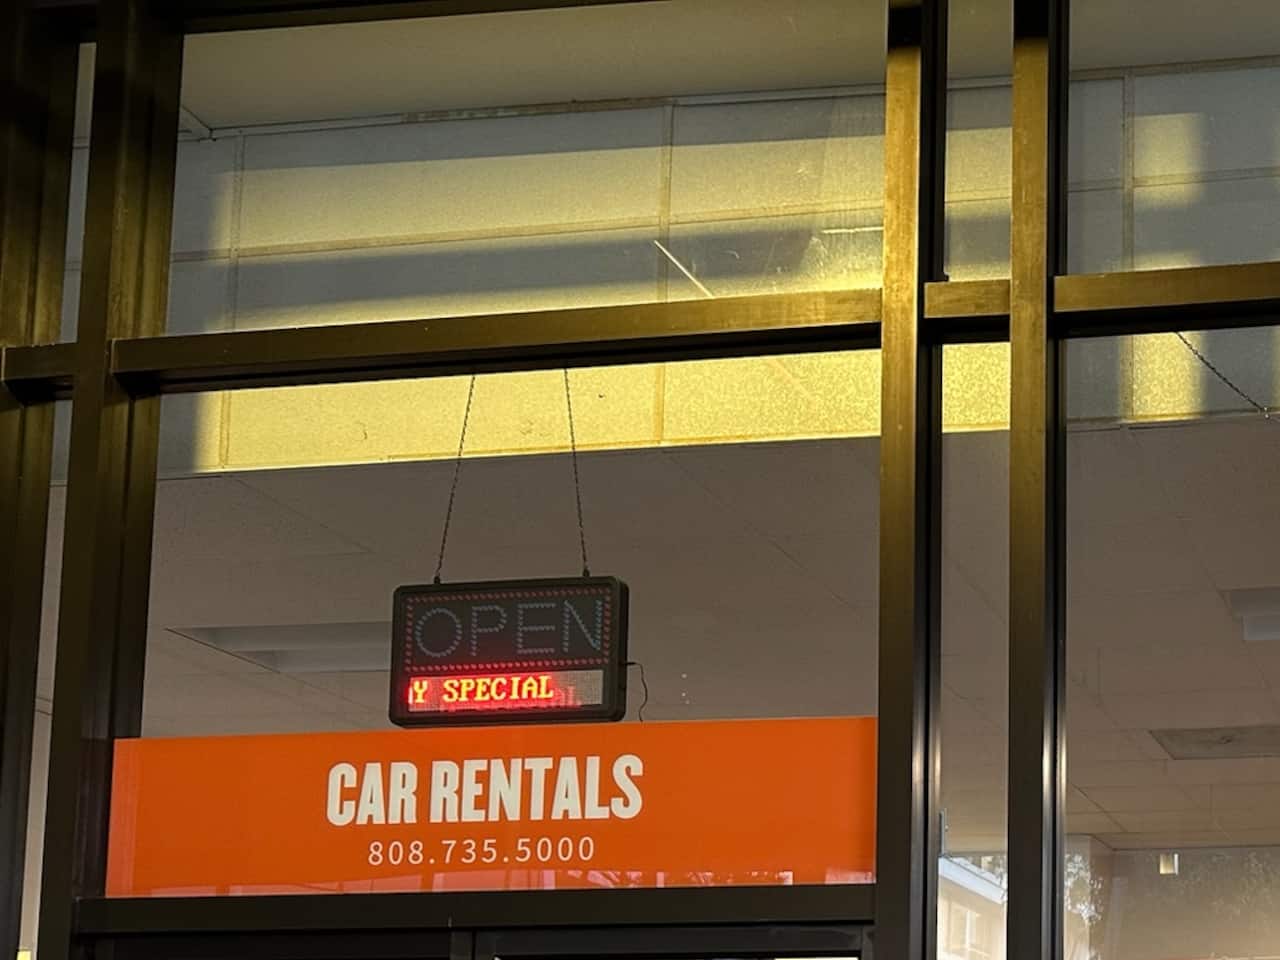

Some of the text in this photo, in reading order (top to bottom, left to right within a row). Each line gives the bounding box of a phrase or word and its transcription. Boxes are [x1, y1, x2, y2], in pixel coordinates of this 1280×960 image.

[414, 599, 602, 658] OPEN
[443, 675, 555, 703] SPECIAL
[327, 754, 644, 827] CAR RENTALS
[368, 836, 595, 866] 808.735.5000
